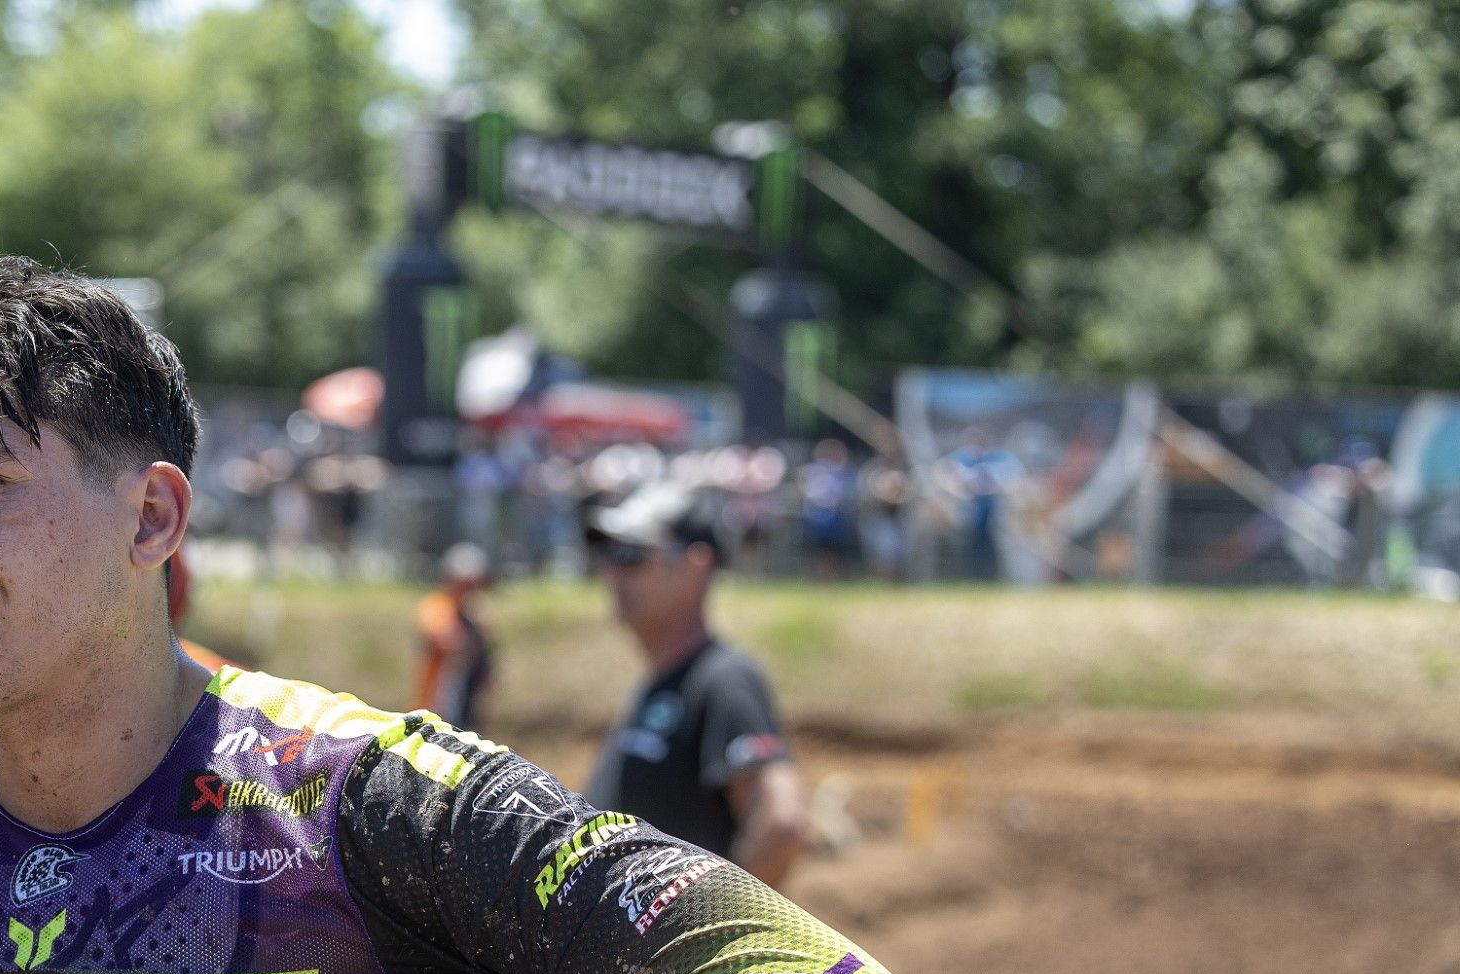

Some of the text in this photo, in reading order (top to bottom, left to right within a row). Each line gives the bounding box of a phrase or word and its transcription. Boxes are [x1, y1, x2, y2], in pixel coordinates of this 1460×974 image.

[177, 847, 303, 877] TRIUMPH
[533, 811, 636, 910] RACING
[634, 857, 728, 935] RENTHAL
